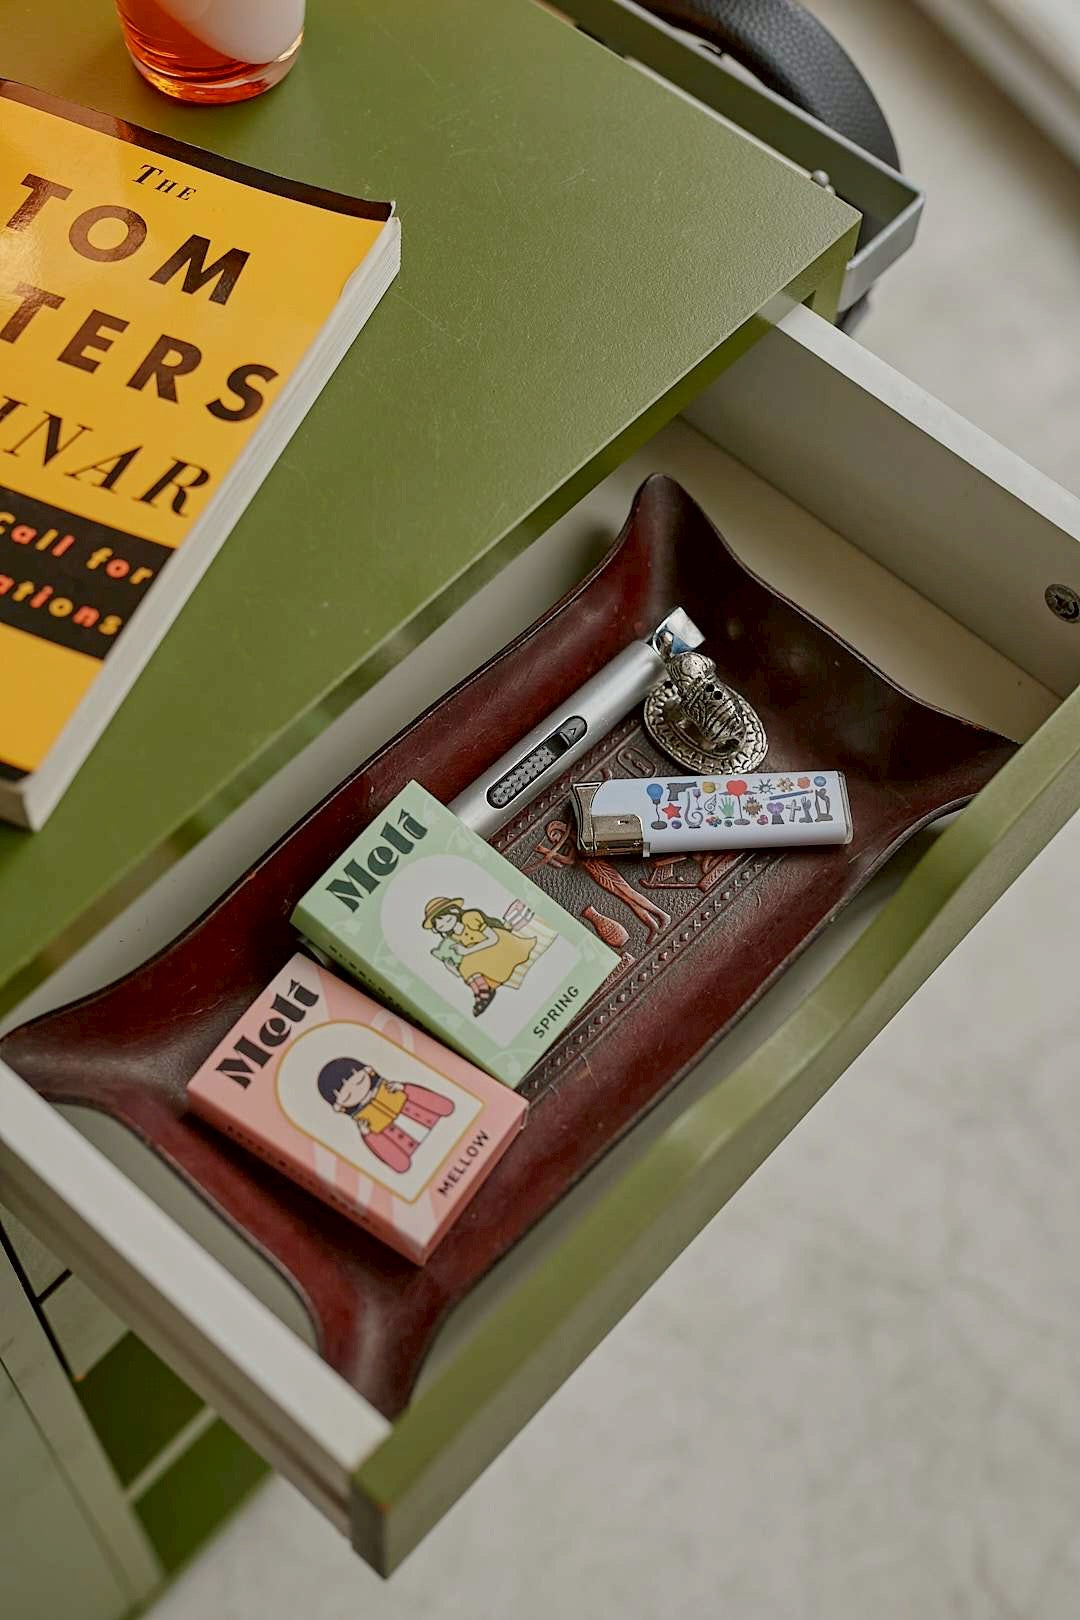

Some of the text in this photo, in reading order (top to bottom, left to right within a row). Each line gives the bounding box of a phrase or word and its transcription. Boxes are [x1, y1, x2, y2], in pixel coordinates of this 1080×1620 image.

[131, 164, 197, 201] THE
[4, 173, 251, 306] TOM
[0, 281, 279, 422] TERS
[86, 547, 153, 585] for
[533, 985, 579, 1038] SPRING
[437, 1129, 489, 1196] MELLOW
